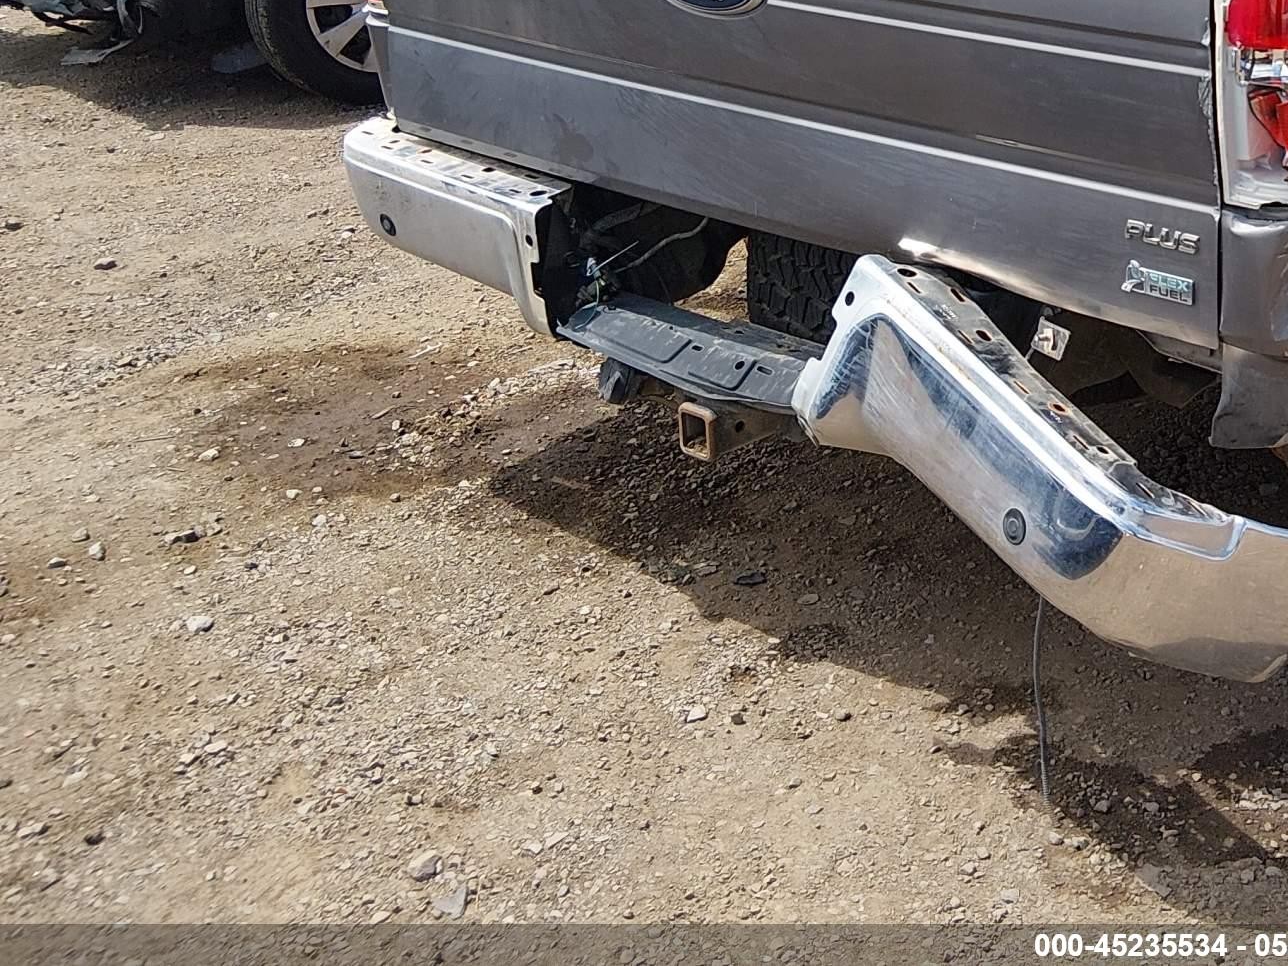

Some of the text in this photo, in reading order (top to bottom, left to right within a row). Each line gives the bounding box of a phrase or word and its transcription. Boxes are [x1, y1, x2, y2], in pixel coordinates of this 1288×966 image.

[1125, 219, 1200, 255] PLUS
[1149, 272, 1189, 292] FLEX
[1149, 284, 1188, 303] FUEL
